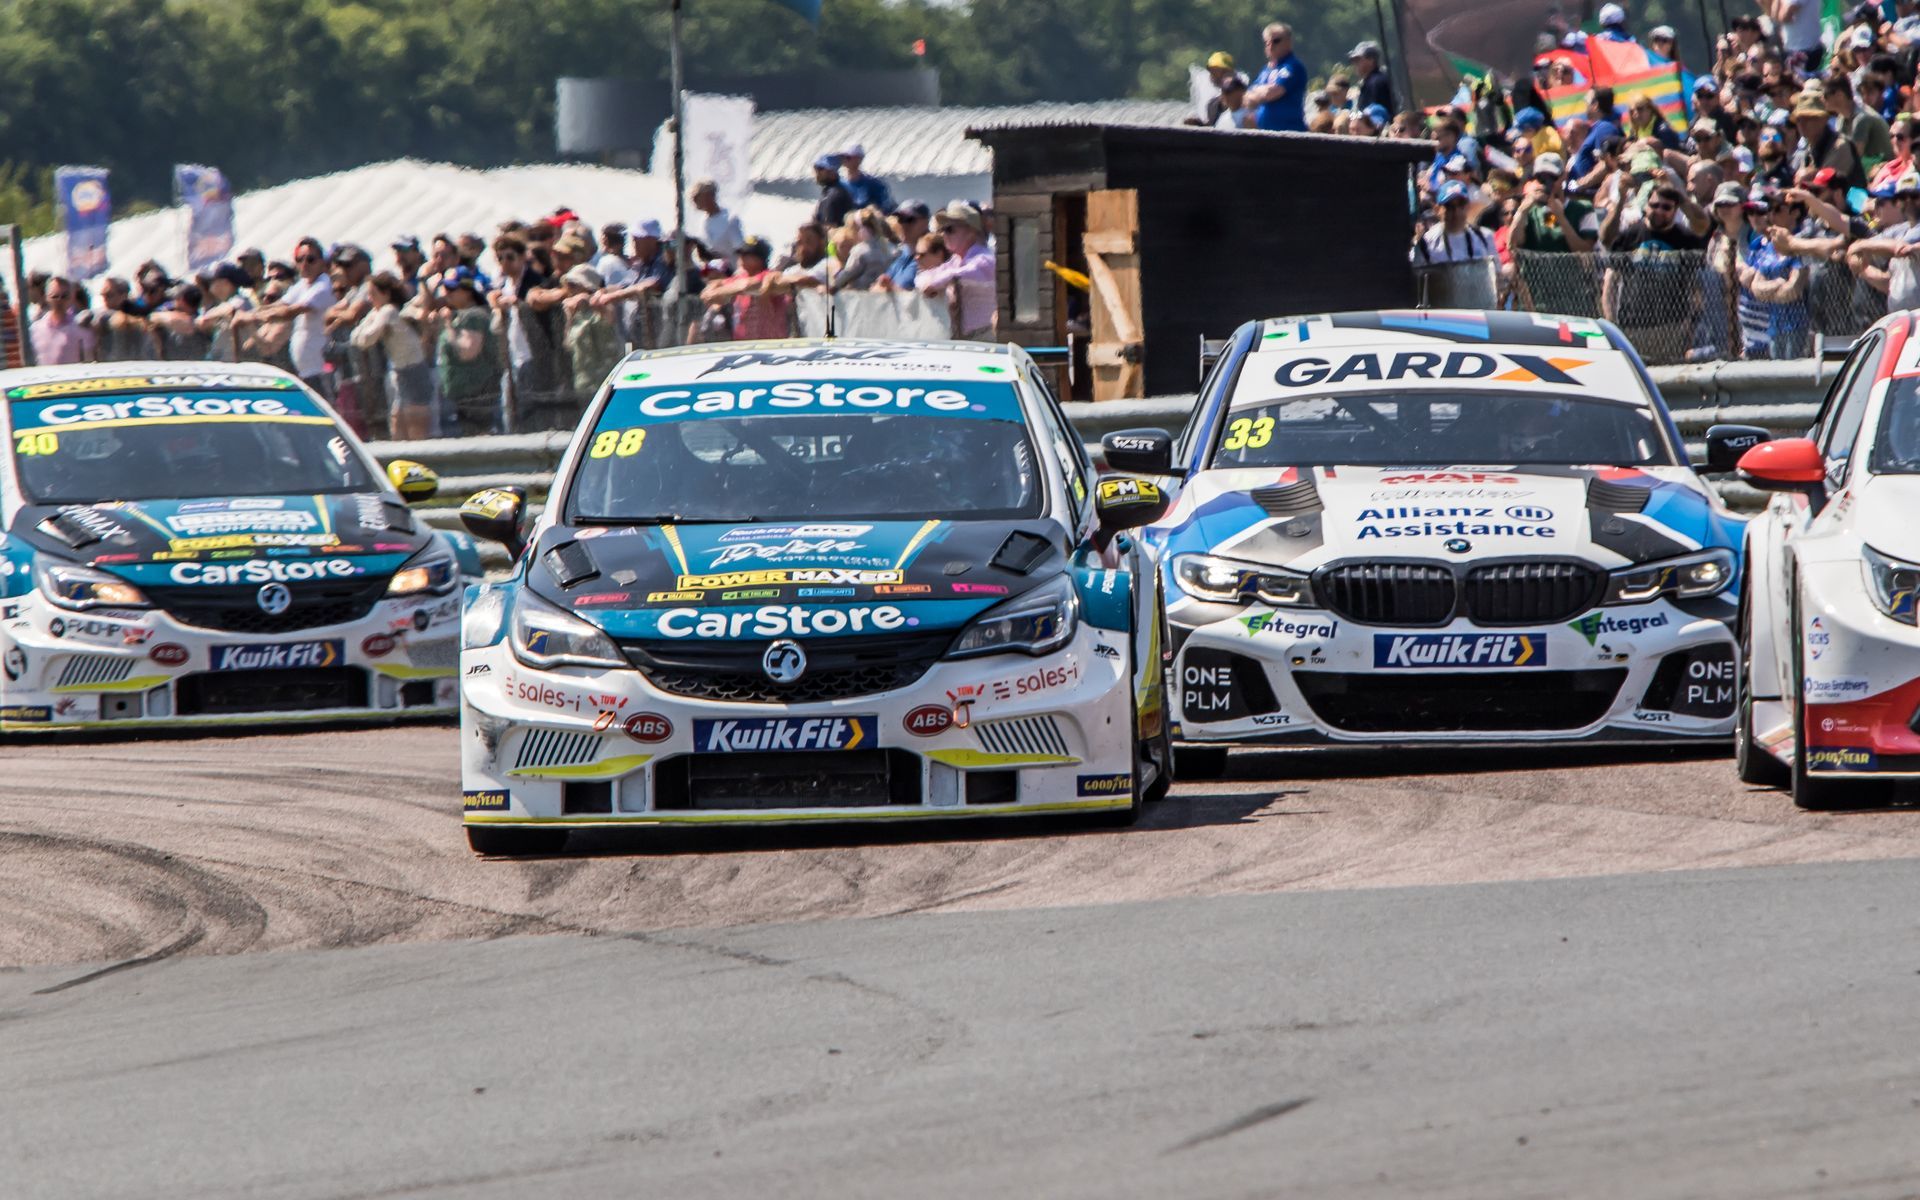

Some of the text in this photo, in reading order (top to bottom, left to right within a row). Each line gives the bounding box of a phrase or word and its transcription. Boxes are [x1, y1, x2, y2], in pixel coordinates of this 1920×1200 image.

[1274, 351, 1593, 386] GARDX
[1224, 417, 1275, 450] 33
[16, 433, 58, 456] 40
[590, 428, 647, 459] 88
[1356, 506, 1494, 521] Allianz
[1357, 522, 1556, 539] Assistance
[683, 568, 898, 588] POWER MAXED
[1247, 615, 1338, 639] Entegral
[1580, 612, 1668, 636] Entegral
[1094, 644, 1120, 656] JFA
[466, 664, 491, 675] JFA
[1310, 656, 1327, 664] TOW
[1016, 662, 1079, 694] sales-i
[1185, 666, 1231, 685] ONE
[1689, 661, 1734, 679] ONE
[518, 680, 580, 712] sales-i
[601, 694, 618, 706] TOW
[1185, 691, 1230, 710] PLM
[1688, 685, 1732, 703] PLM
[630, 719, 666, 735] ABS
[912, 713, 948, 727] ABS
[1252, 715, 1290, 724] WSR
[1084, 775, 1133, 796] GOODYEA
